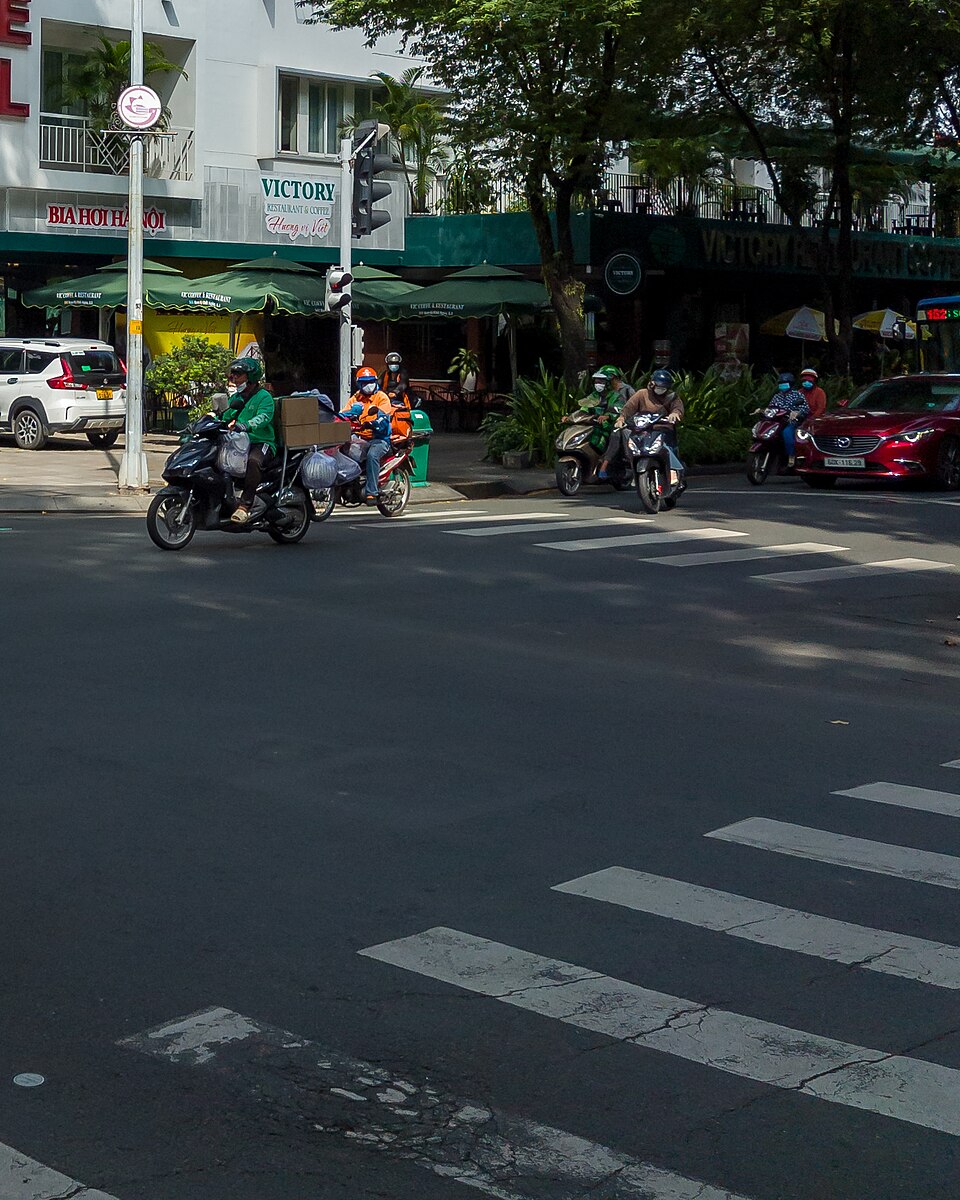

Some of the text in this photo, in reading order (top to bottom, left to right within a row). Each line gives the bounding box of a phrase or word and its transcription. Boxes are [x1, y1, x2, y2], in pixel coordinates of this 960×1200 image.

[261, 178, 335, 201] VICTORY
[48, 205, 77, 225] BIA
[266, 203, 303, 214] RESTAURANT
[309, 206, 330, 216] COFFEE
[702, 230, 792, 266] VICTORY
